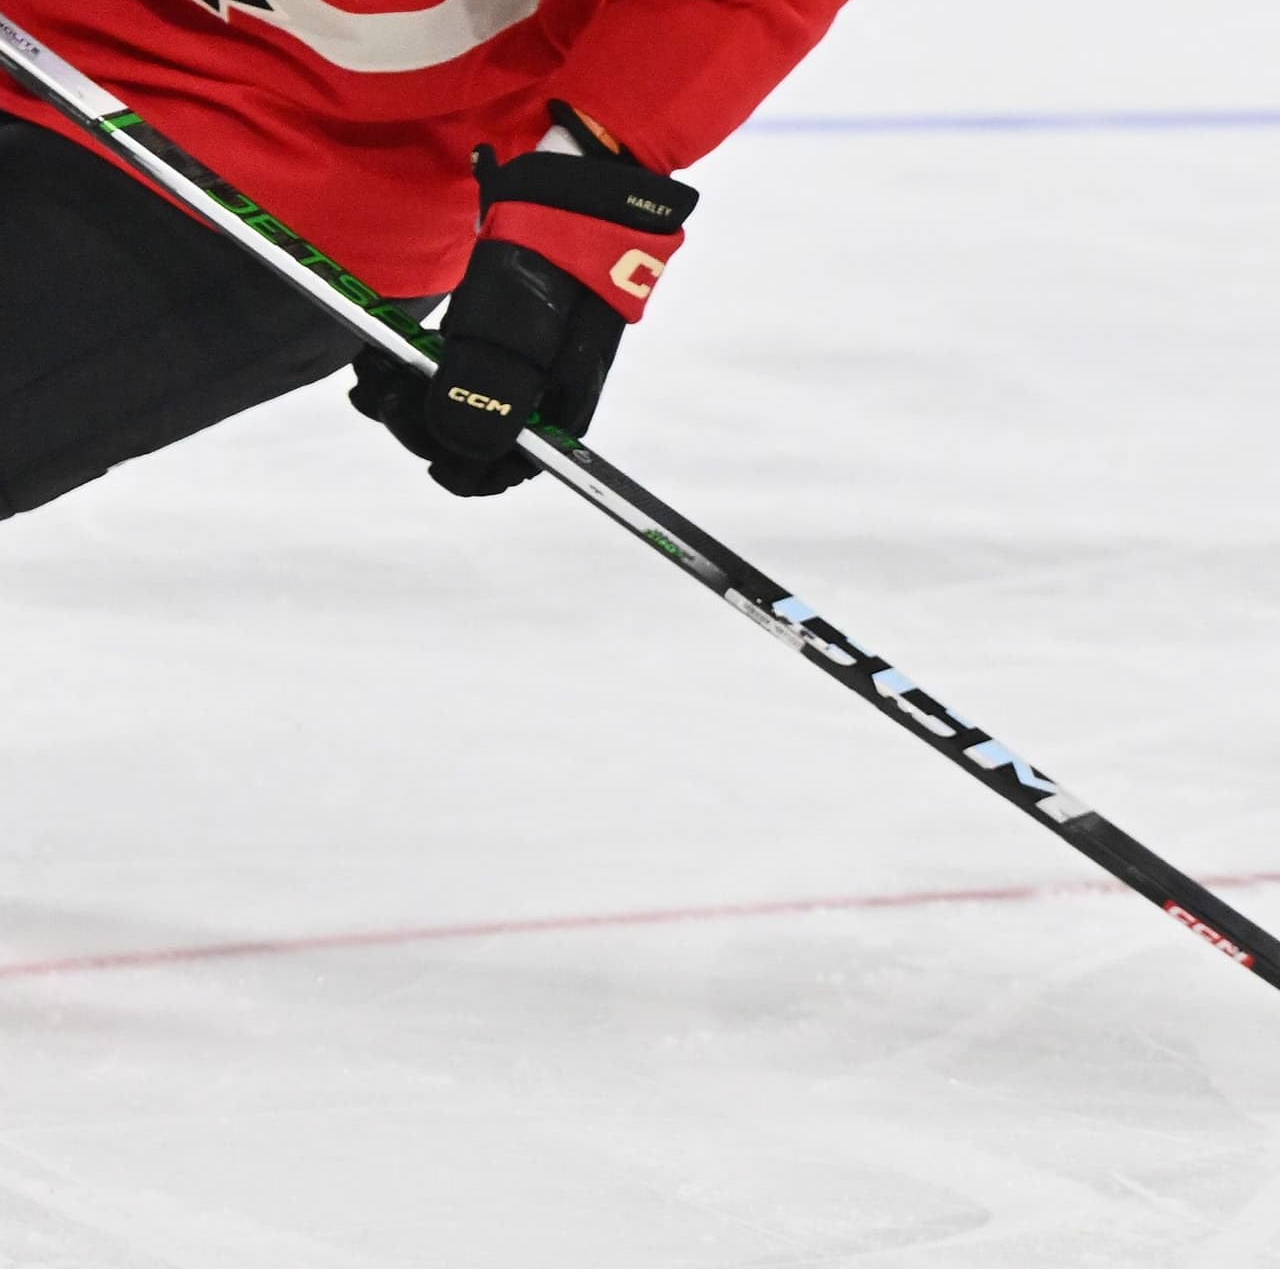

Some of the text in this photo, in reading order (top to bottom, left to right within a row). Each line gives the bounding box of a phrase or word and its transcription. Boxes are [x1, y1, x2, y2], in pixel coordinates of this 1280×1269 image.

[626, 193, 673, 218] HARLEY
[447, 385, 513, 417] CCM
[772, 594, 1095, 824] CCM
